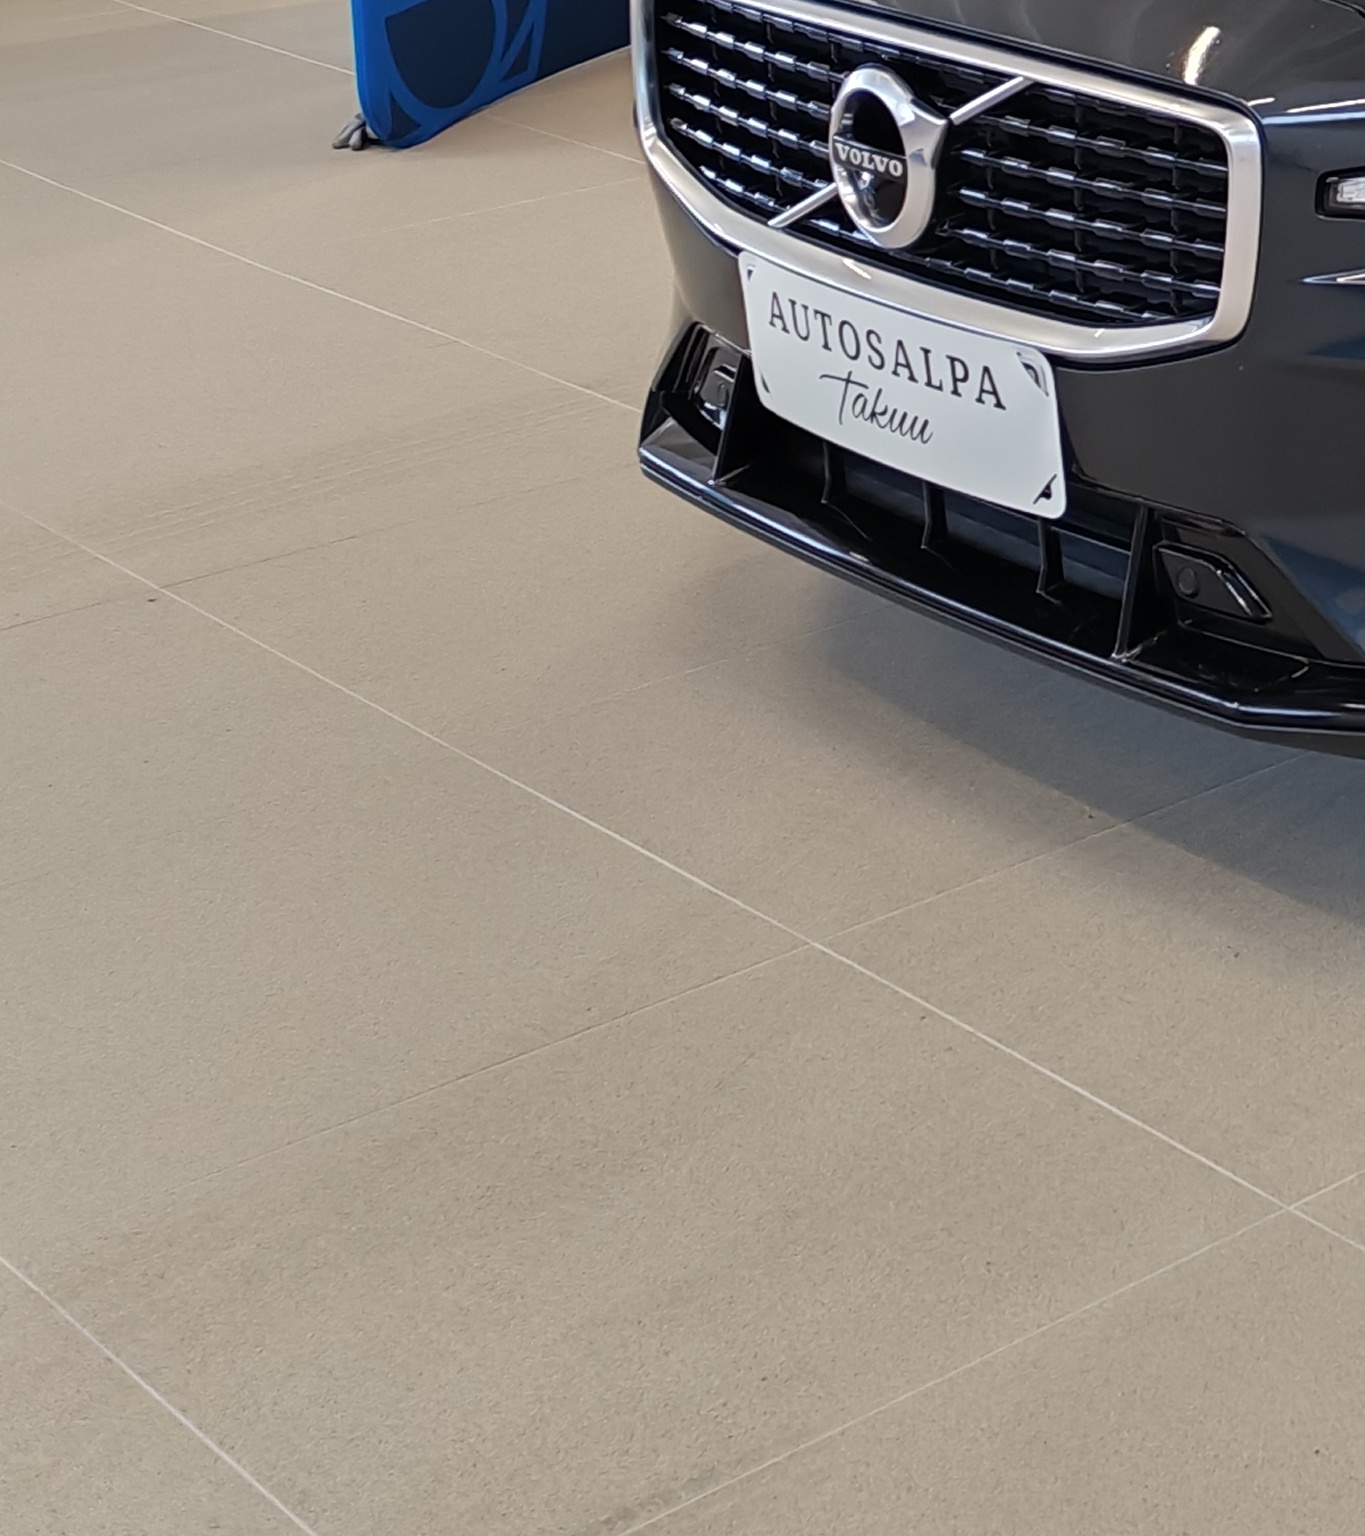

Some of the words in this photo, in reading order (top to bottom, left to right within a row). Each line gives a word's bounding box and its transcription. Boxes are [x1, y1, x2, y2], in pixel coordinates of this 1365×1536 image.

[834, 142, 904, 178] VOLVO
[769, 290, 1008, 411] AUTOSALPA
[818, 370, 934, 445] Takuu
